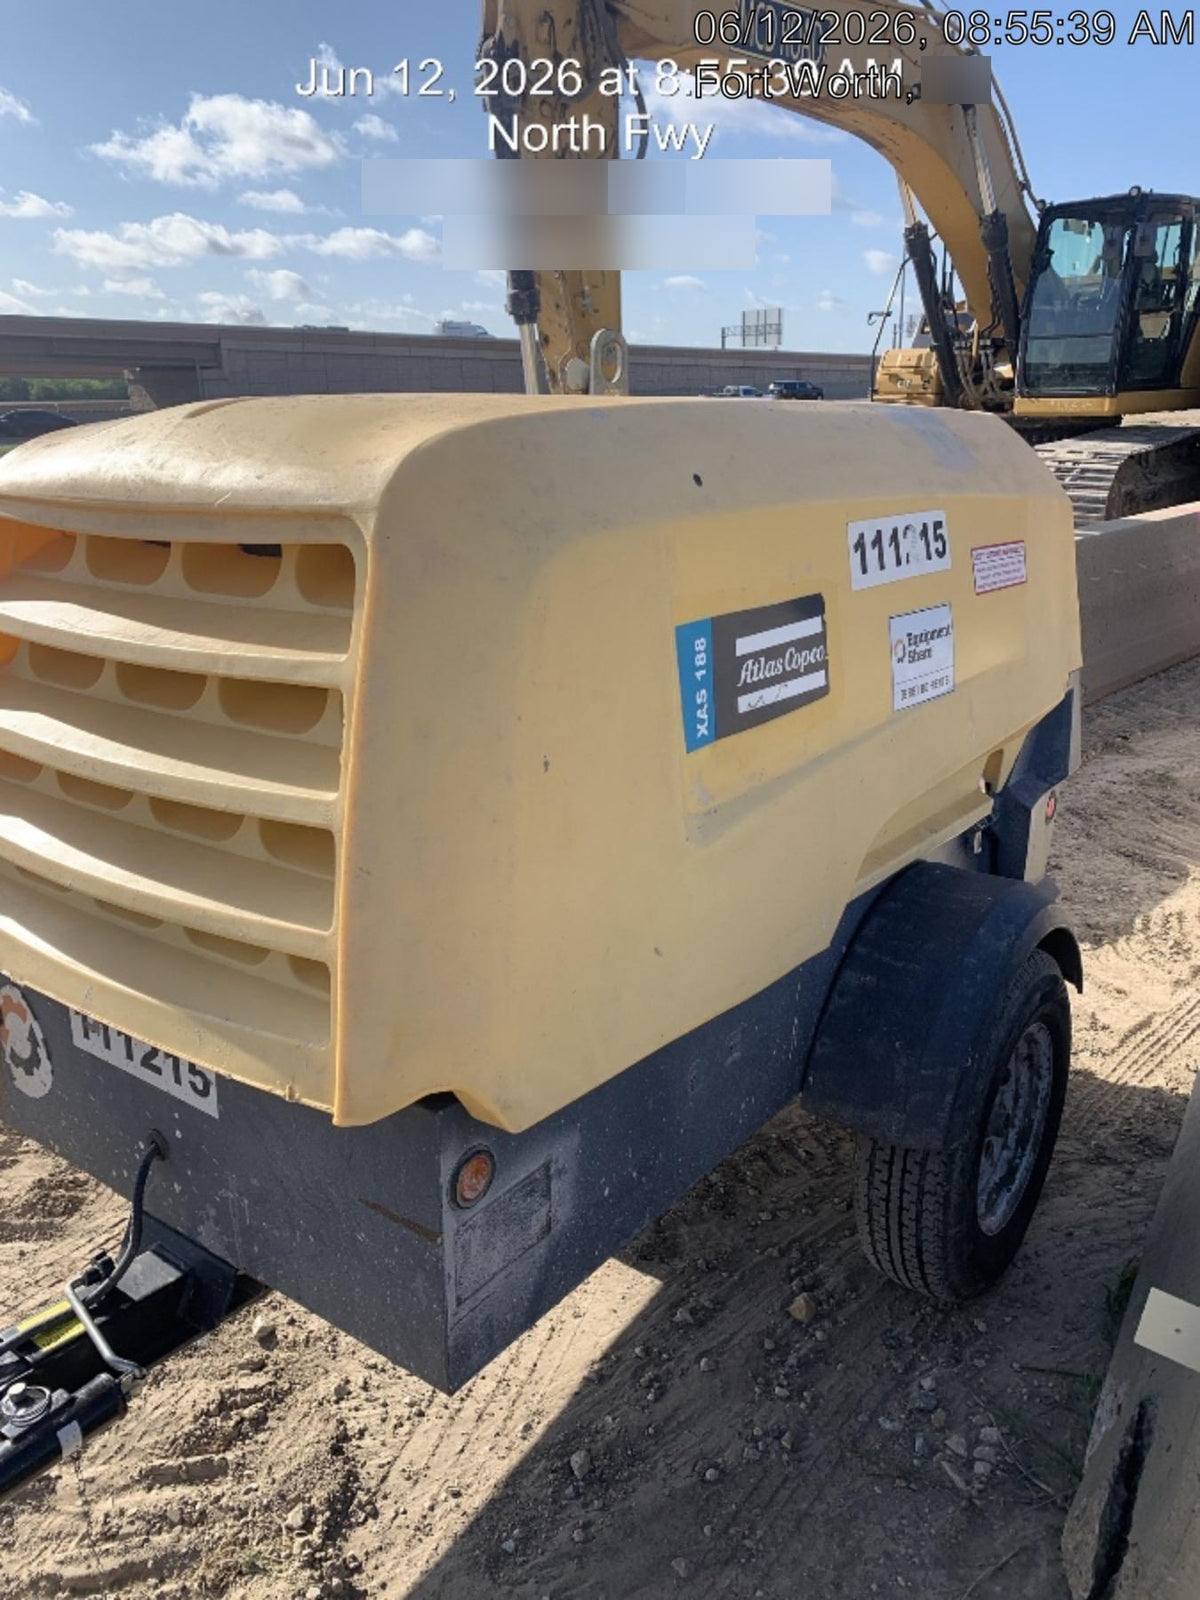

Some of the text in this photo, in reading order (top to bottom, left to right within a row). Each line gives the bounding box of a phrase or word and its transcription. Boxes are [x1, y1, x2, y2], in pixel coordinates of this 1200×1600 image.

[694, 637, 709, 739] XAS 188
[736, 645, 826, 687] Atlas Copco
